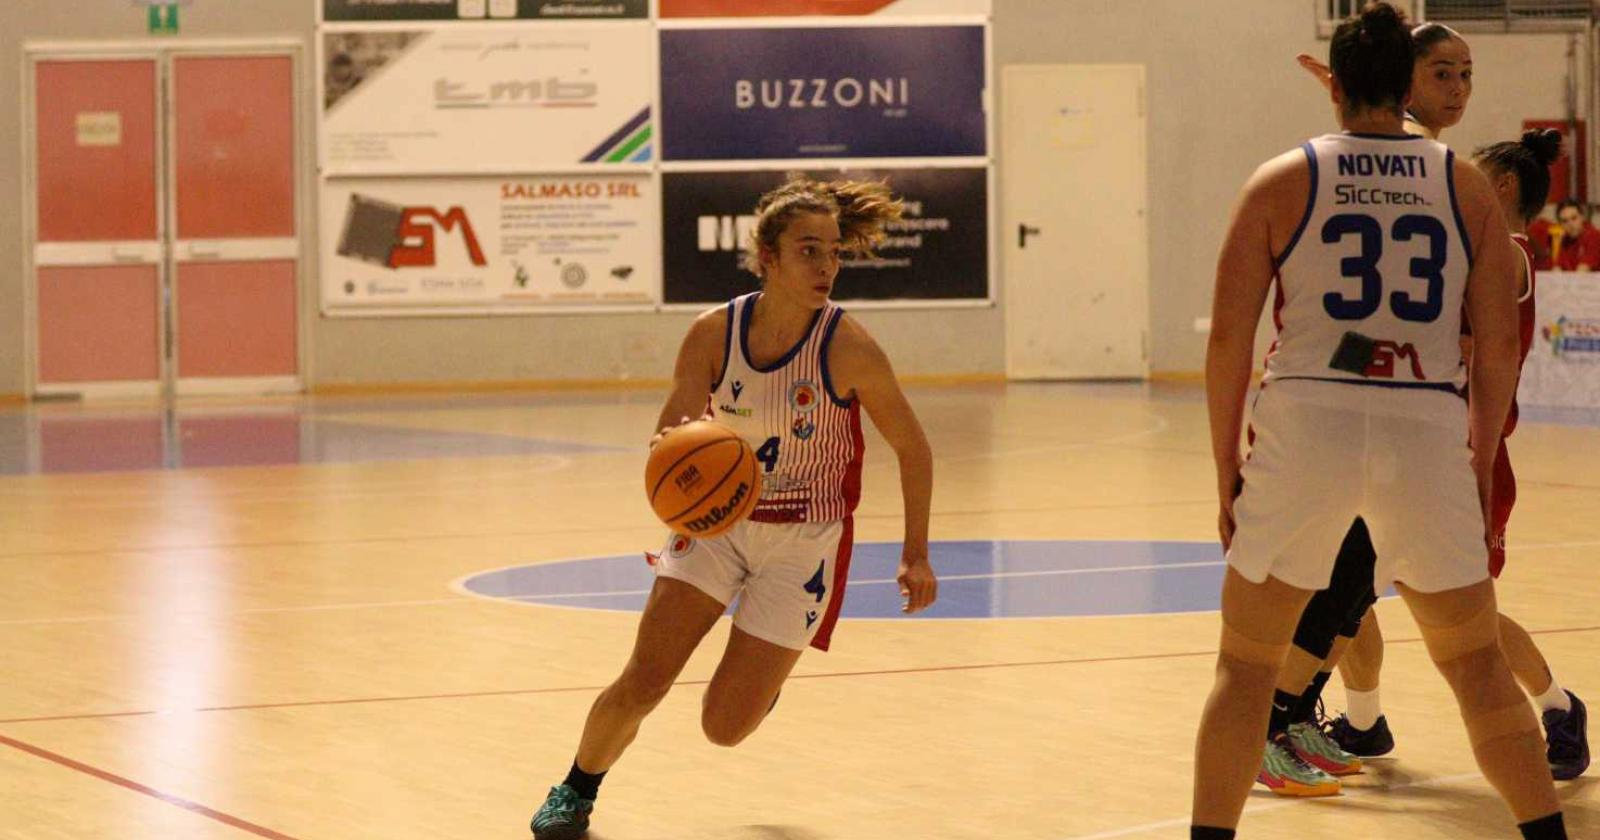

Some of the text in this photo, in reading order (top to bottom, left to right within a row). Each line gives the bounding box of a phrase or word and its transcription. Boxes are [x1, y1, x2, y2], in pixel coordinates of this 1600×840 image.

[735, 77, 909, 109] BUZZONI
[1337, 153, 1427, 178] NOVATI
[500, 182, 641, 199] SALMASO SRL
[1321, 213, 1448, 323] 33
[755, 436, 781, 473] 4
[673, 463, 701, 489] FIBA
[683, 480, 750, 532] Wilson
[803, 558, 827, 604] 4
